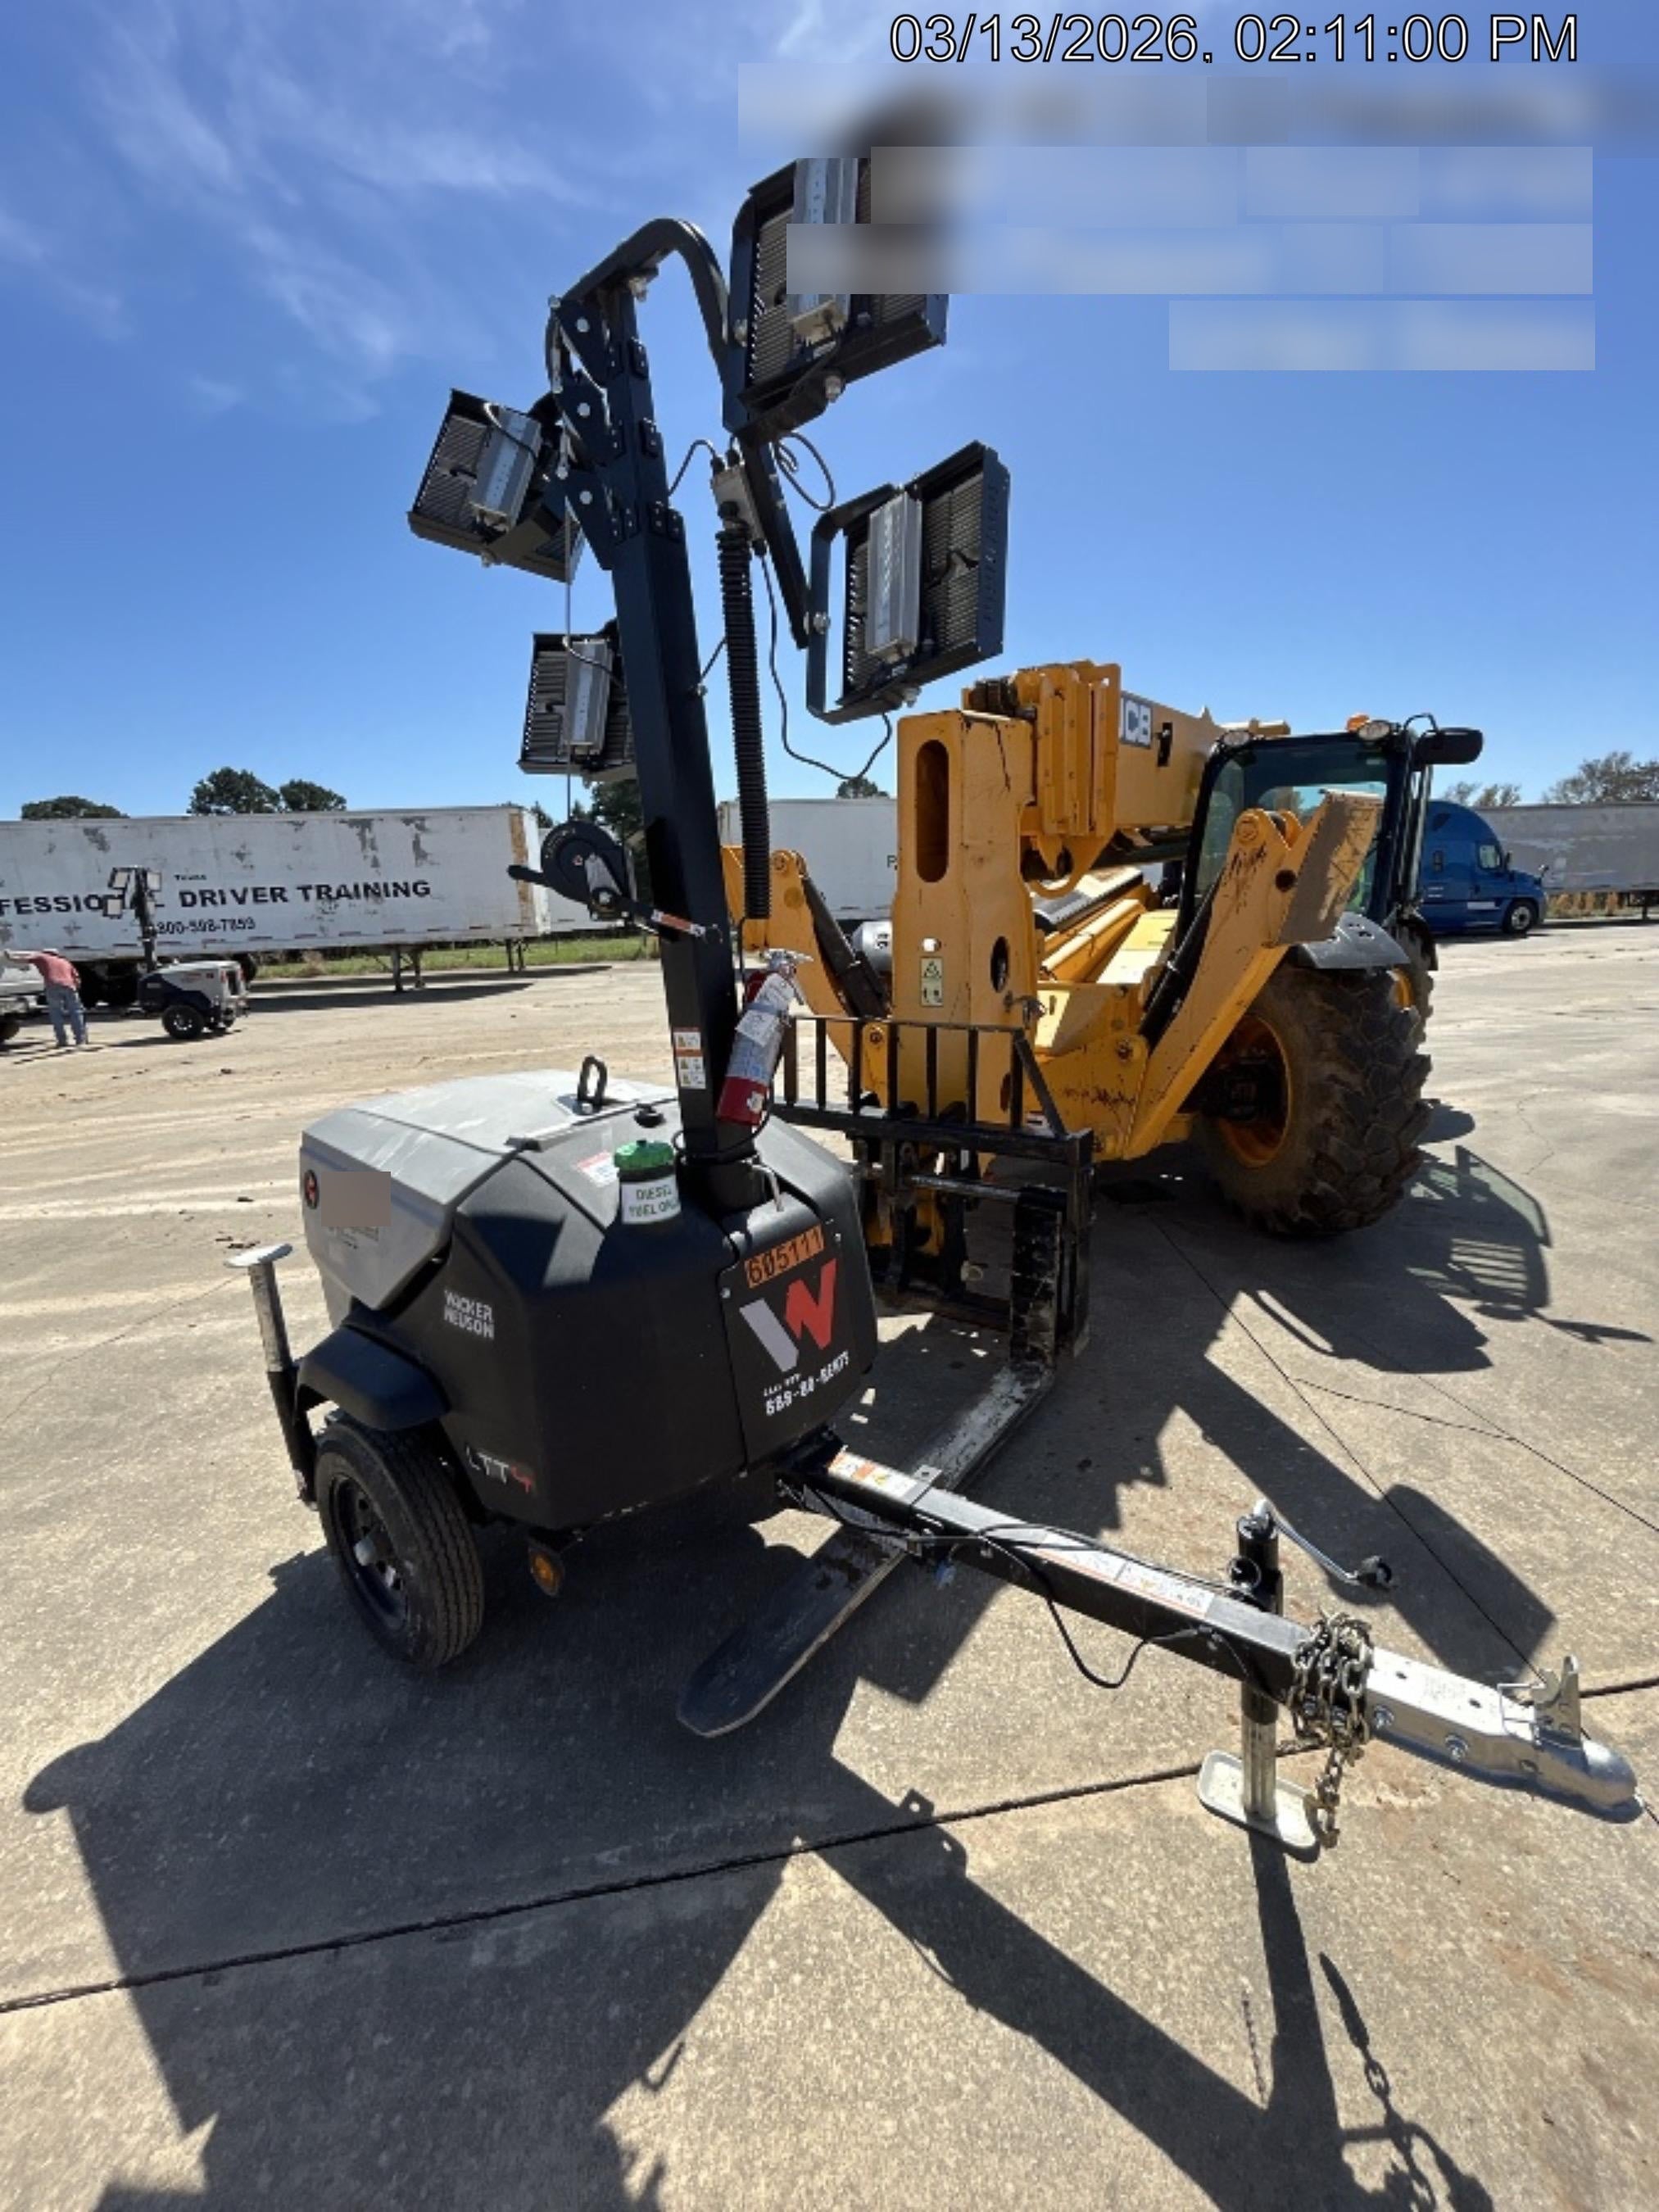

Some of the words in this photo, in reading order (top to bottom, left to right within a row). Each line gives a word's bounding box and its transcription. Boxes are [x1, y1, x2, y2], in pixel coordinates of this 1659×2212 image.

[1124, 698, 1151, 746] CB
[179, 886, 288, 908] DRIVER
[296, 879, 432, 900] TRAINING
[749, 1229, 823, 1281] 605111
